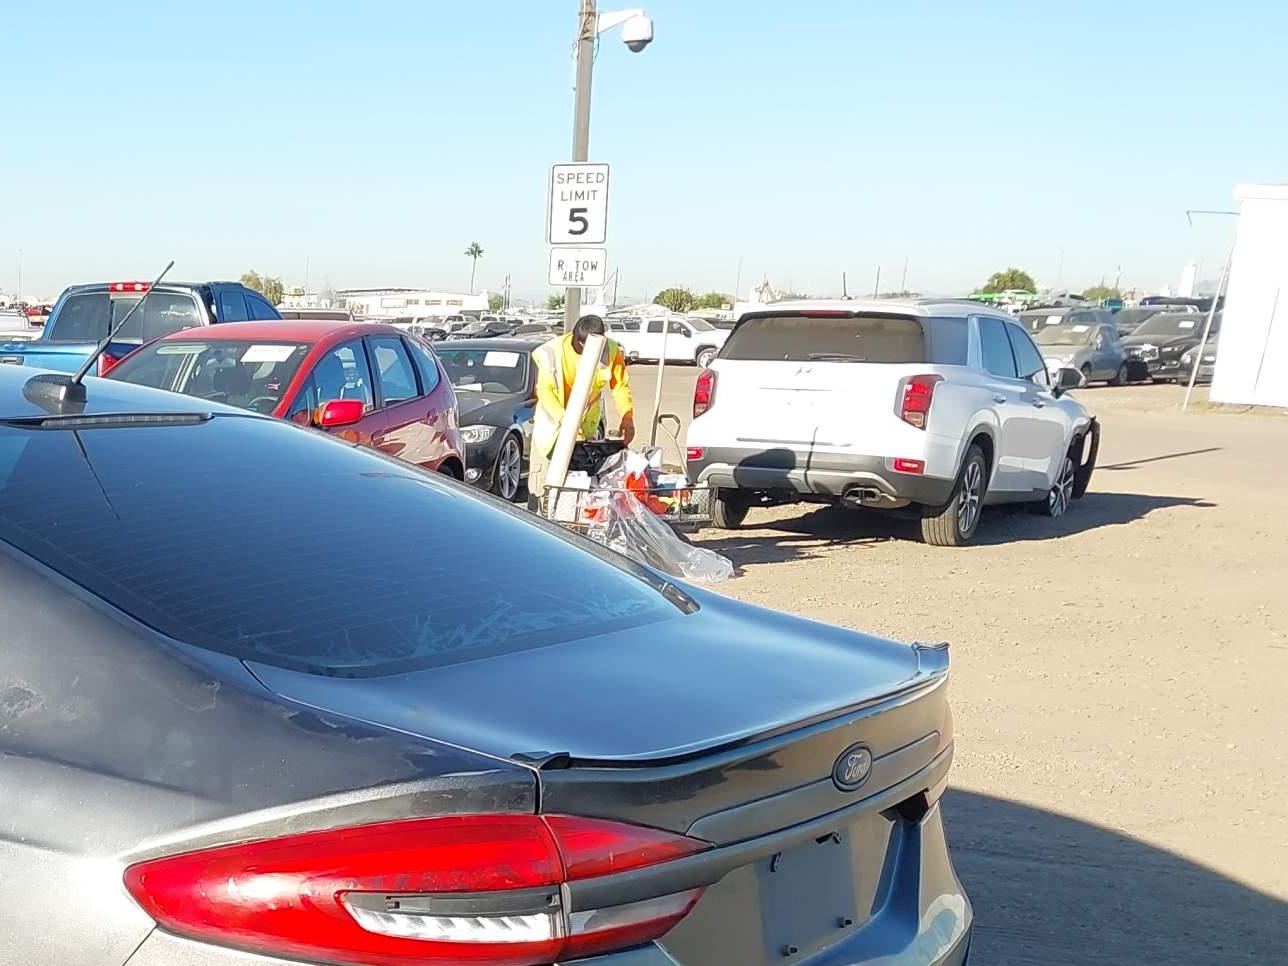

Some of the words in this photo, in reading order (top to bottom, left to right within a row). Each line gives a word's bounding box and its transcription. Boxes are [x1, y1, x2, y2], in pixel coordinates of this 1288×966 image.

[556, 173, 604, 184] SPEED
[561, 190, 599, 201] LIMIT
[567, 207, 589, 236] 5
[575, 260, 598, 271] TOW
[562, 271, 585, 282] AREA
